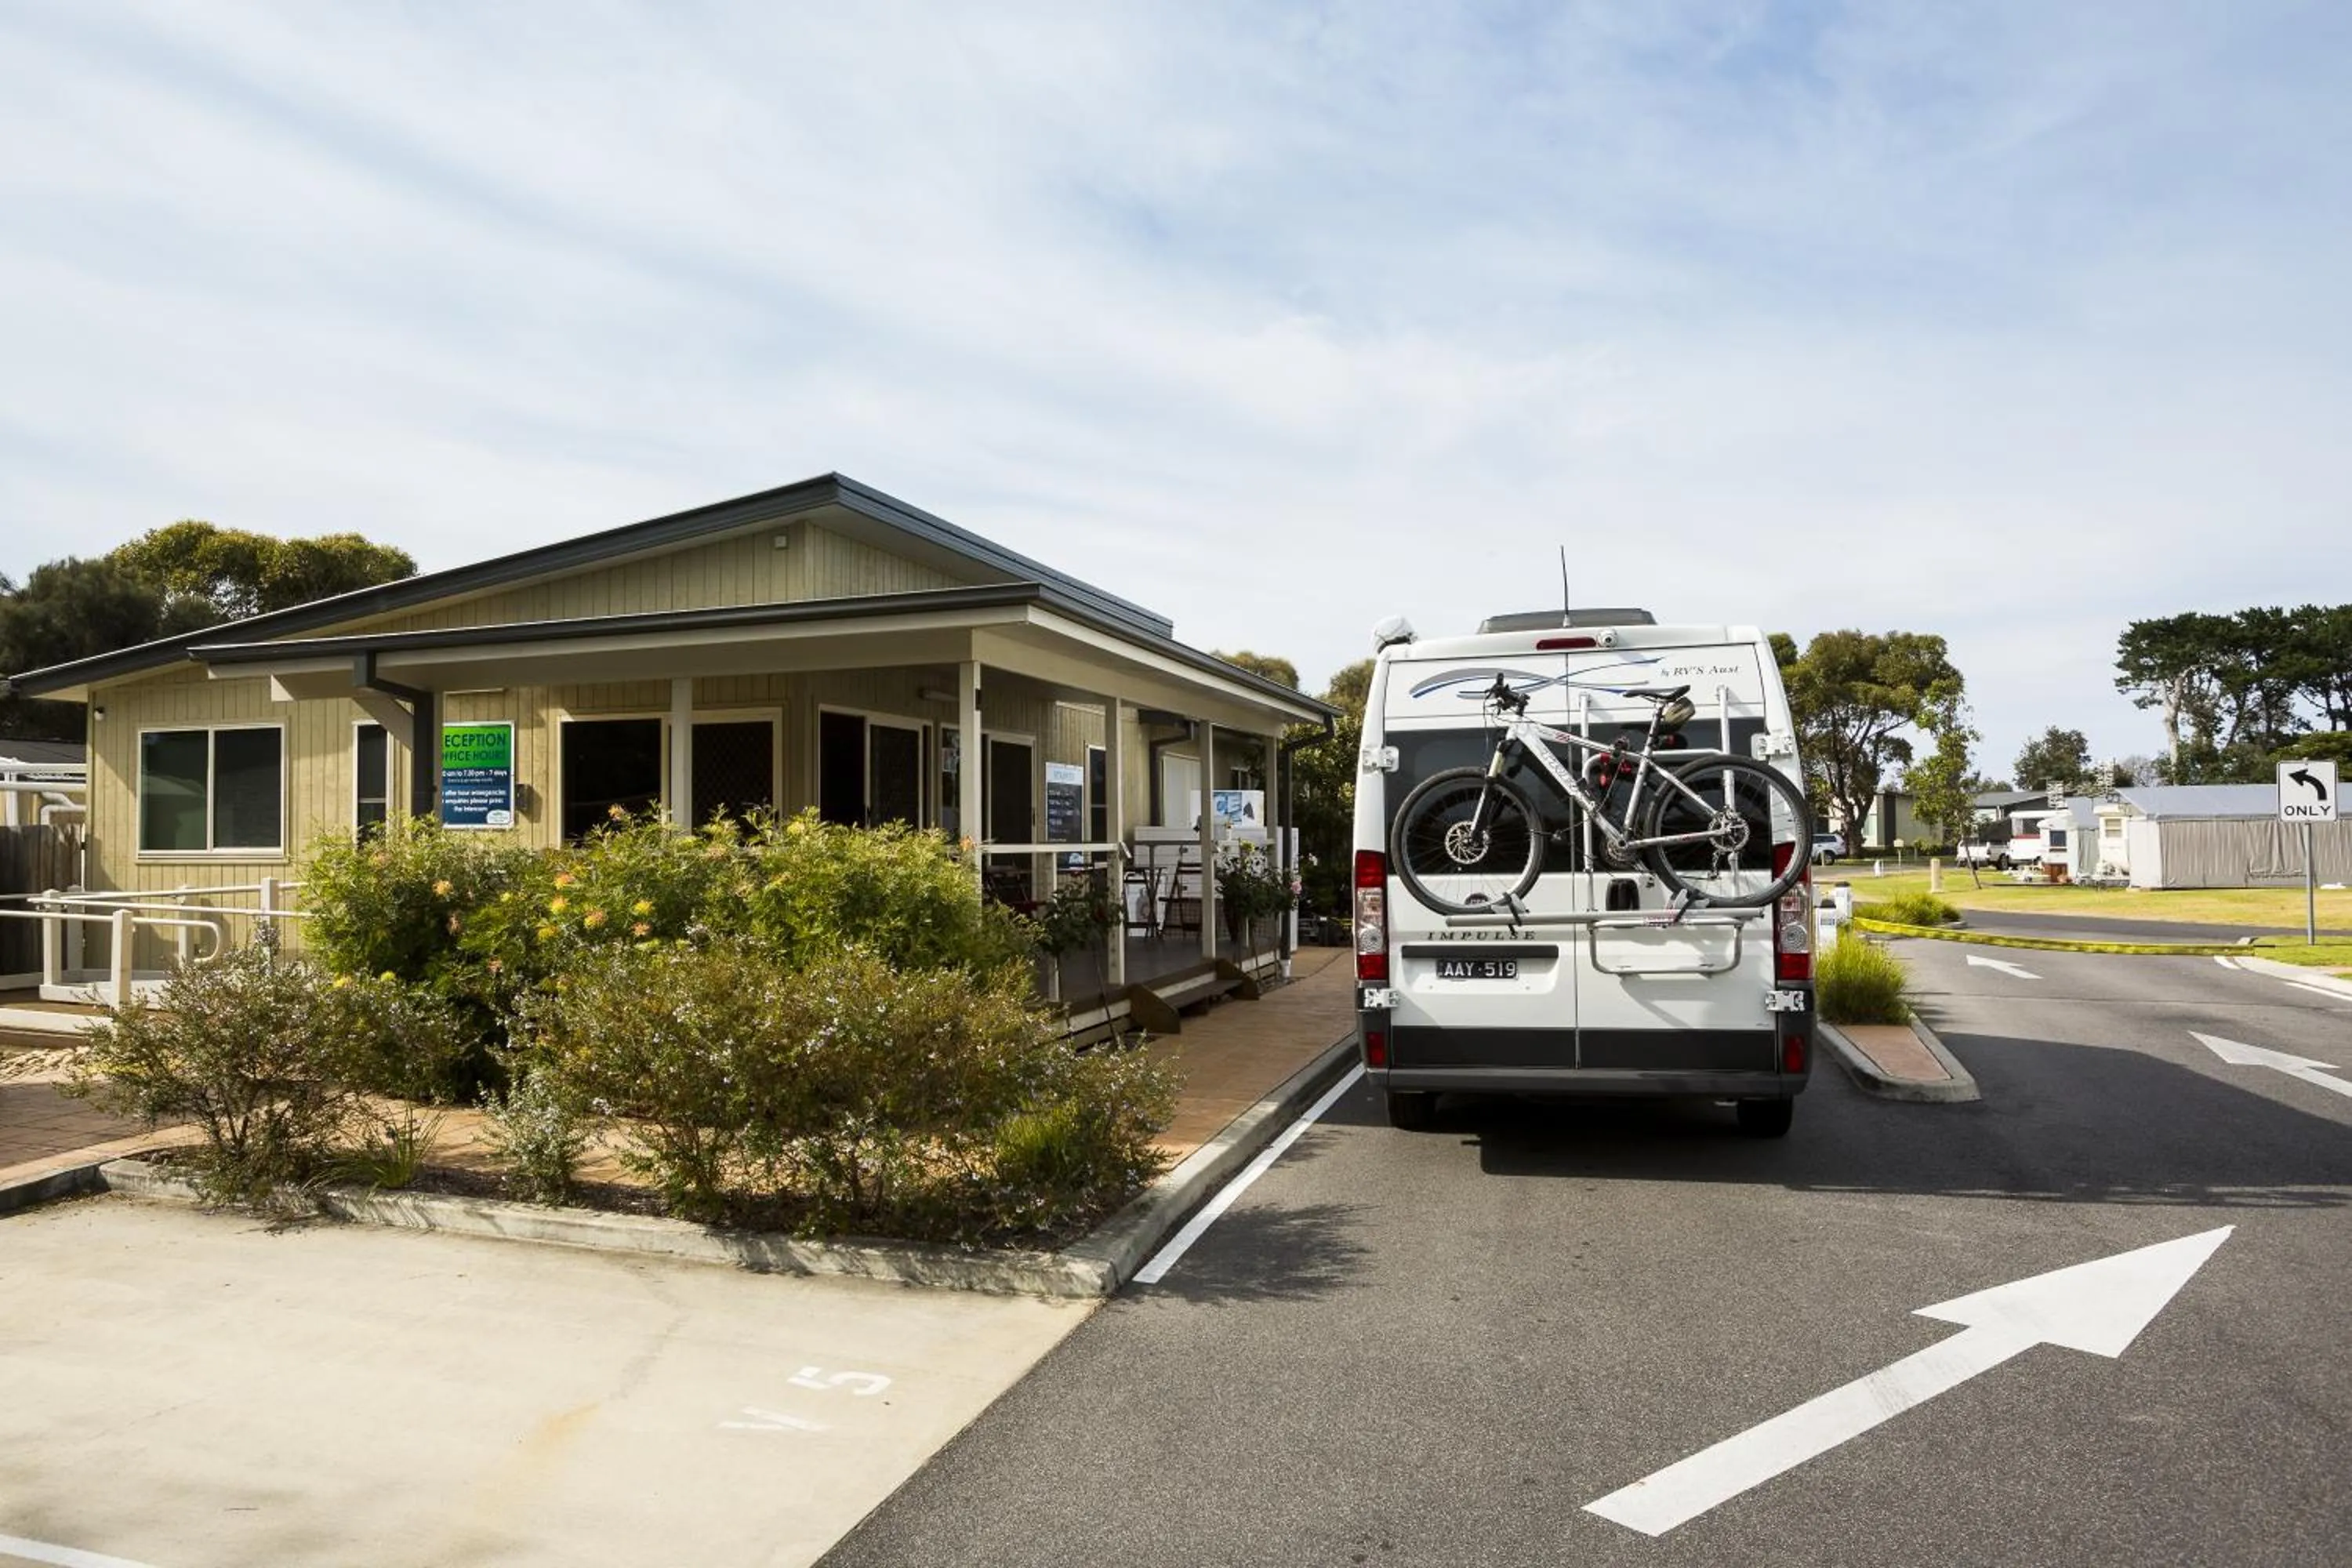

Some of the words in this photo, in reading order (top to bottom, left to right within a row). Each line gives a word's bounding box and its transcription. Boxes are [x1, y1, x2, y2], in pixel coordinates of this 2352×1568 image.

[444, 734, 506, 747] ECEPTION
[442, 751, 471, 761] FFICE
[2284, 805, 2331, 816] ONLY
[1427, 931, 1537, 941] IMPULSE
